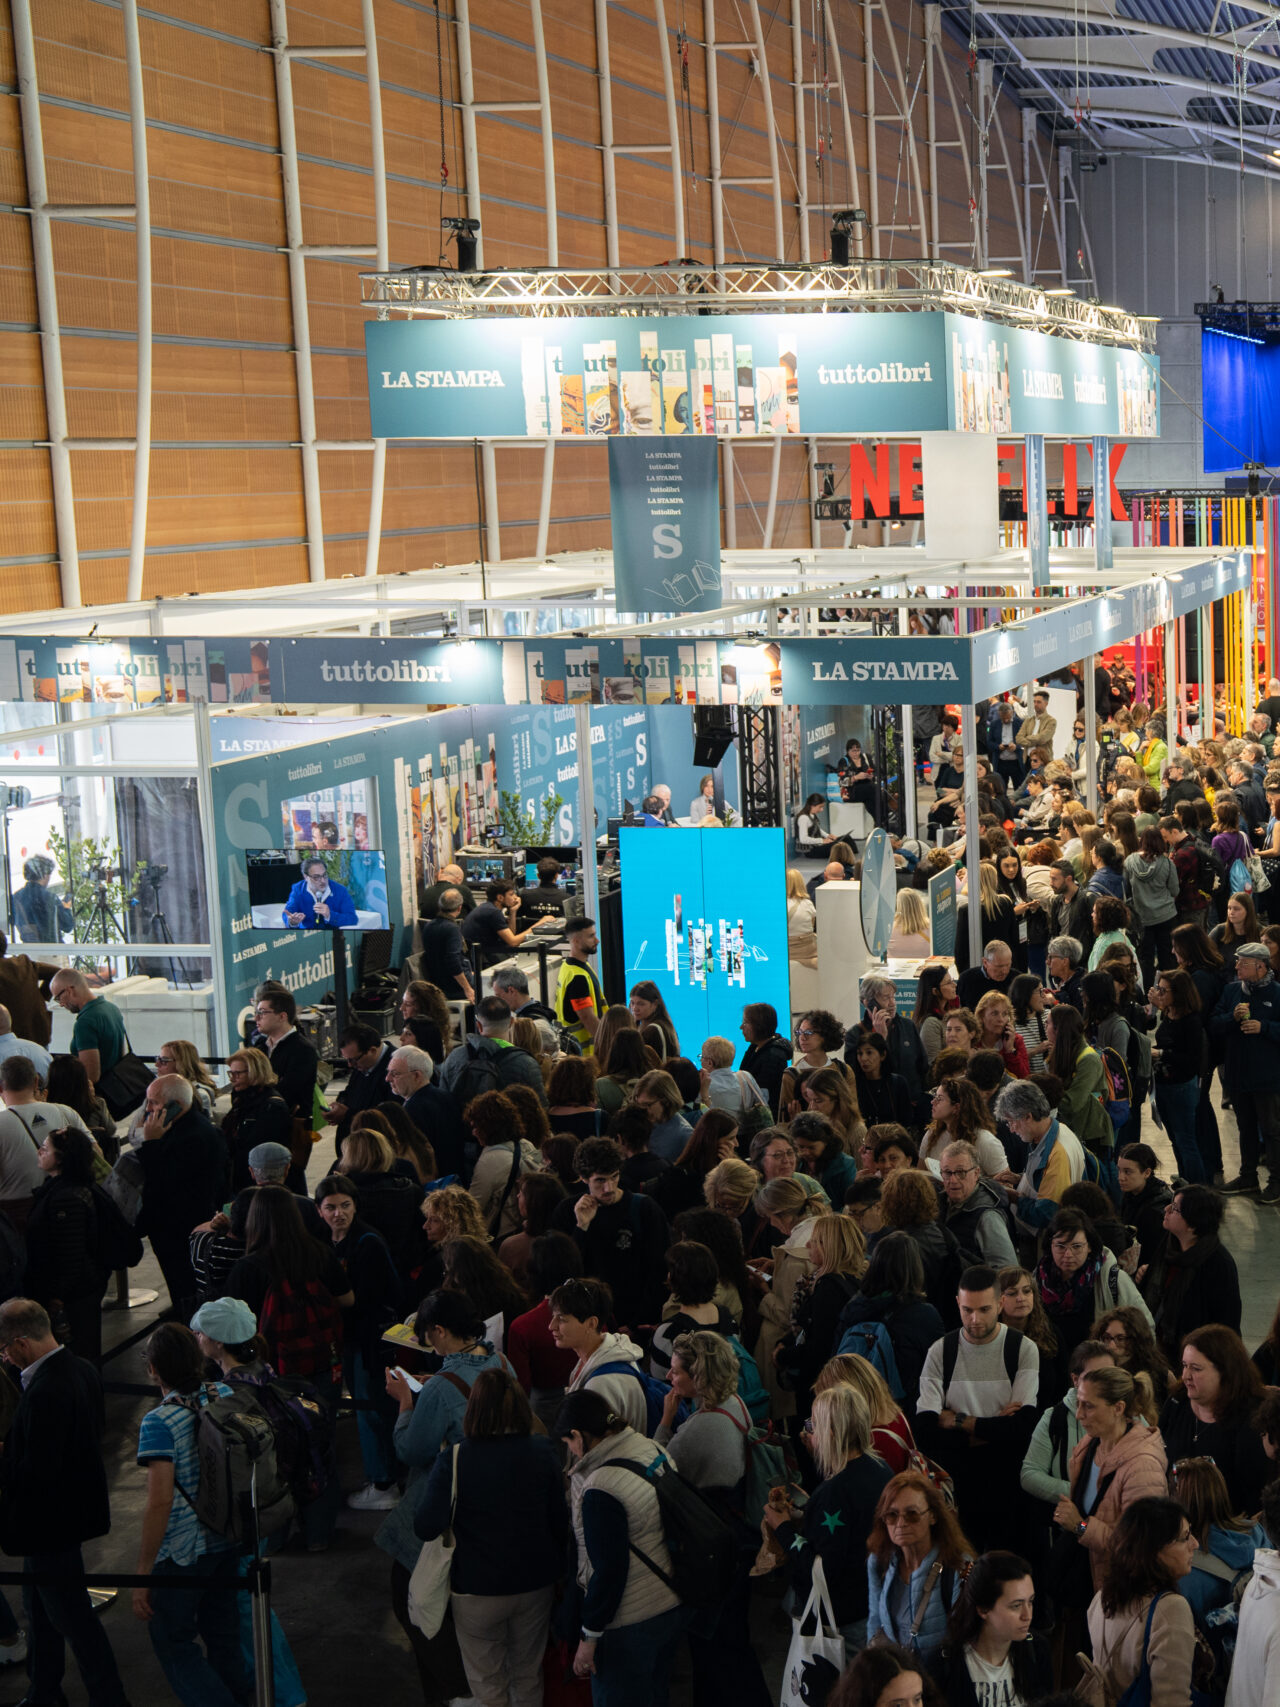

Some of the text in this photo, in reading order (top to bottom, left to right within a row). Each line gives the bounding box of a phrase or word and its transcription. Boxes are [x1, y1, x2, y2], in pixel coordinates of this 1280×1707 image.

[381, 370, 506, 389] LA STAMPA
[817, 362, 933, 385] tuttolibri
[650, 508, 682, 516] tuttolibri
[652, 523, 683, 560] S
[320, 659, 453, 683] tuttolibri
[811, 661, 959, 682] LA STAMPA
[220, 739, 241, 752] LA
[555, 735, 569, 756] LA
[635, 732, 647, 767] S
[627, 767, 635, 790] S
[559, 803, 574, 847] S
